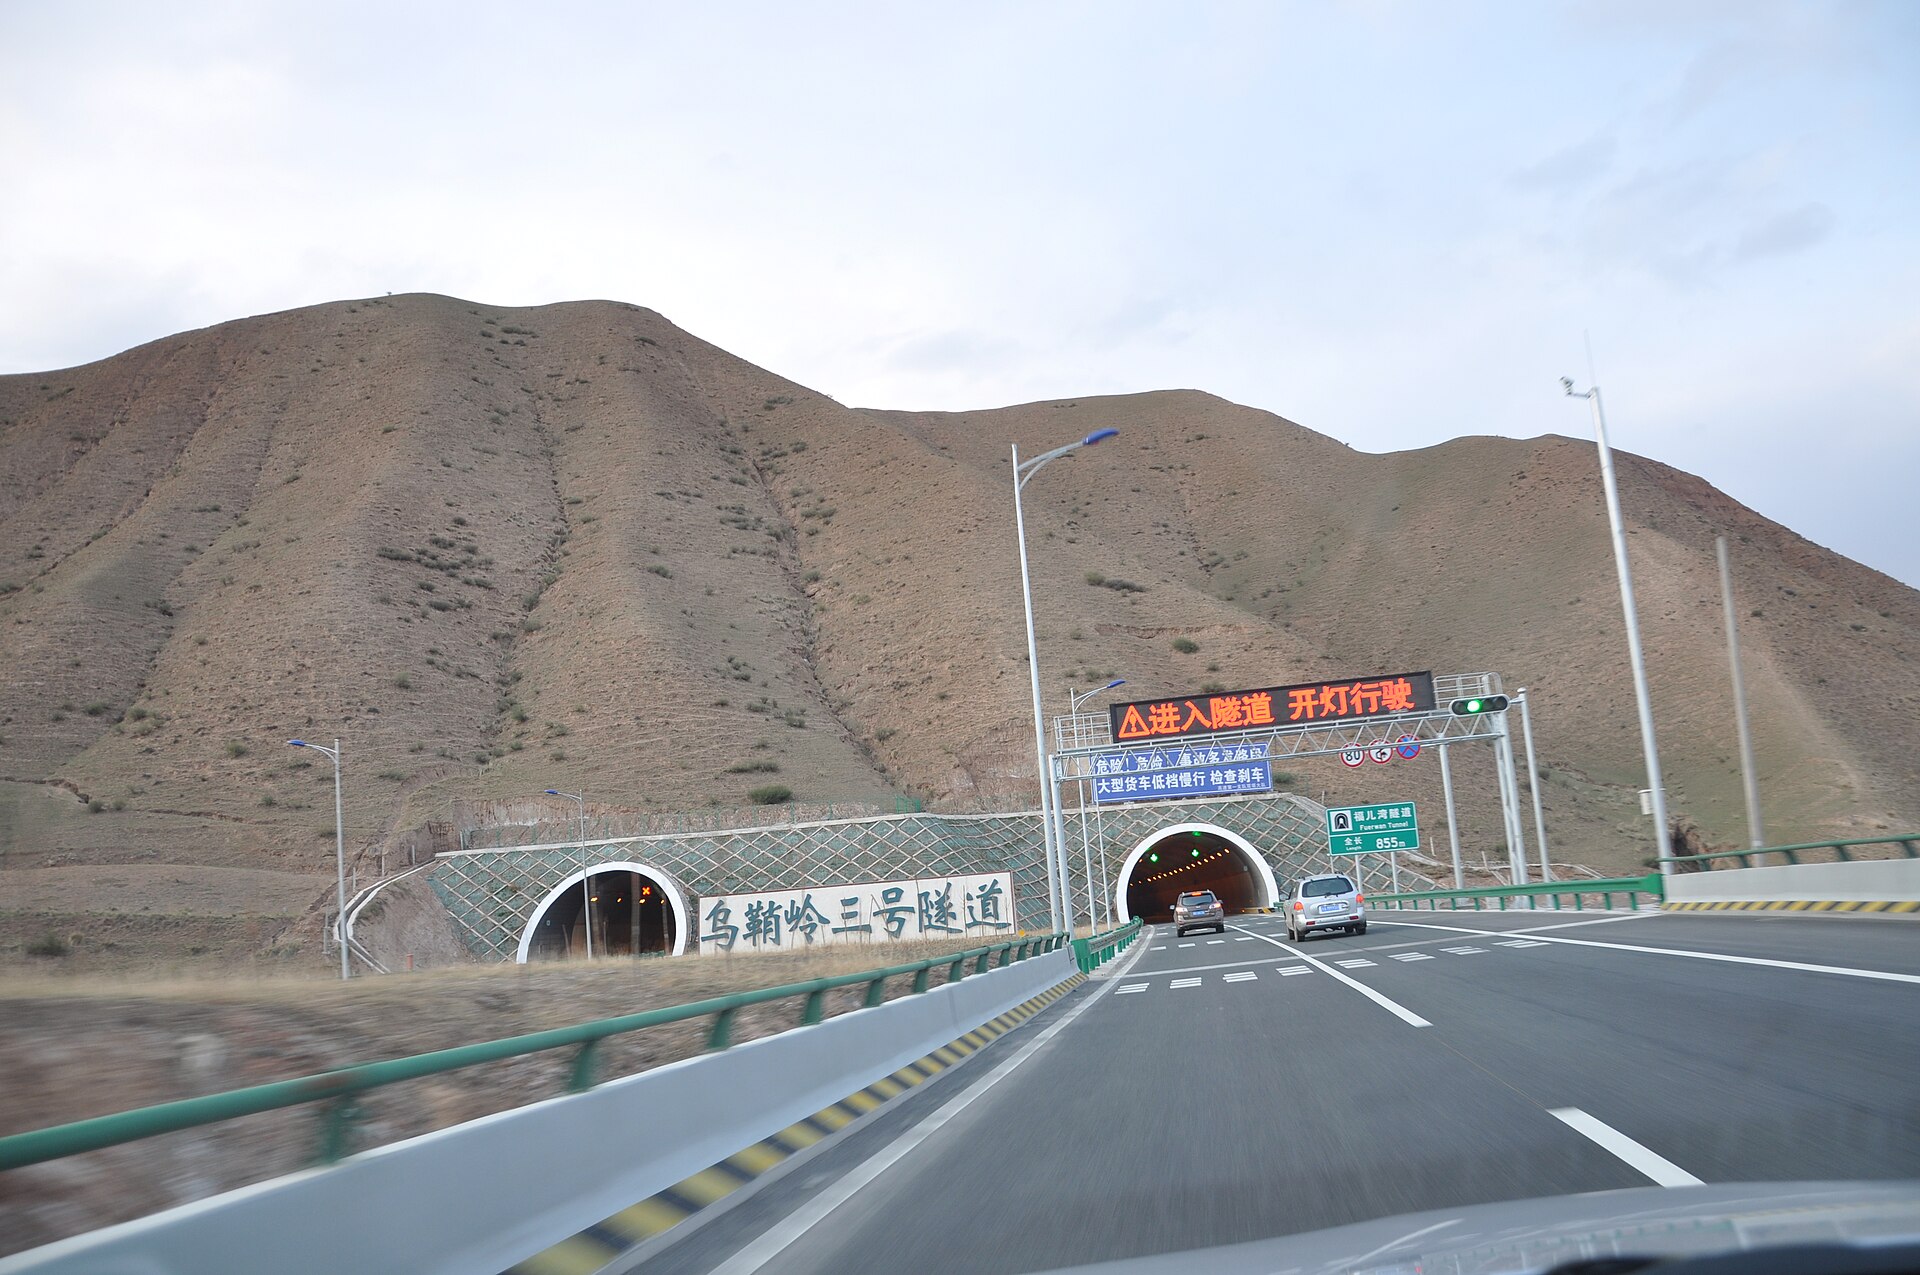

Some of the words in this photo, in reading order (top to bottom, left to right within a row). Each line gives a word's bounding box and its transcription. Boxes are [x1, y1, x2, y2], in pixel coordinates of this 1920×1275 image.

[1148, 692, 1274, 734] 进入隧道
[1288, 677, 1415, 720] 开灯行驶
[1346, 750, 1361, 761] 80
[1097, 771, 1206, 794] 大型货车低档慢行
[1210, 767, 1264, 785] 检查刹车
[1353, 807, 1412, 822] 福儿湾隧道
[1360, 823, 1387, 831] Fuerwan
[1388, 821, 1409, 829] Tunnel
[1344, 836, 1362, 846] 全长
[701, 878, 1012, 950] 乌鞘岭三号隧道
